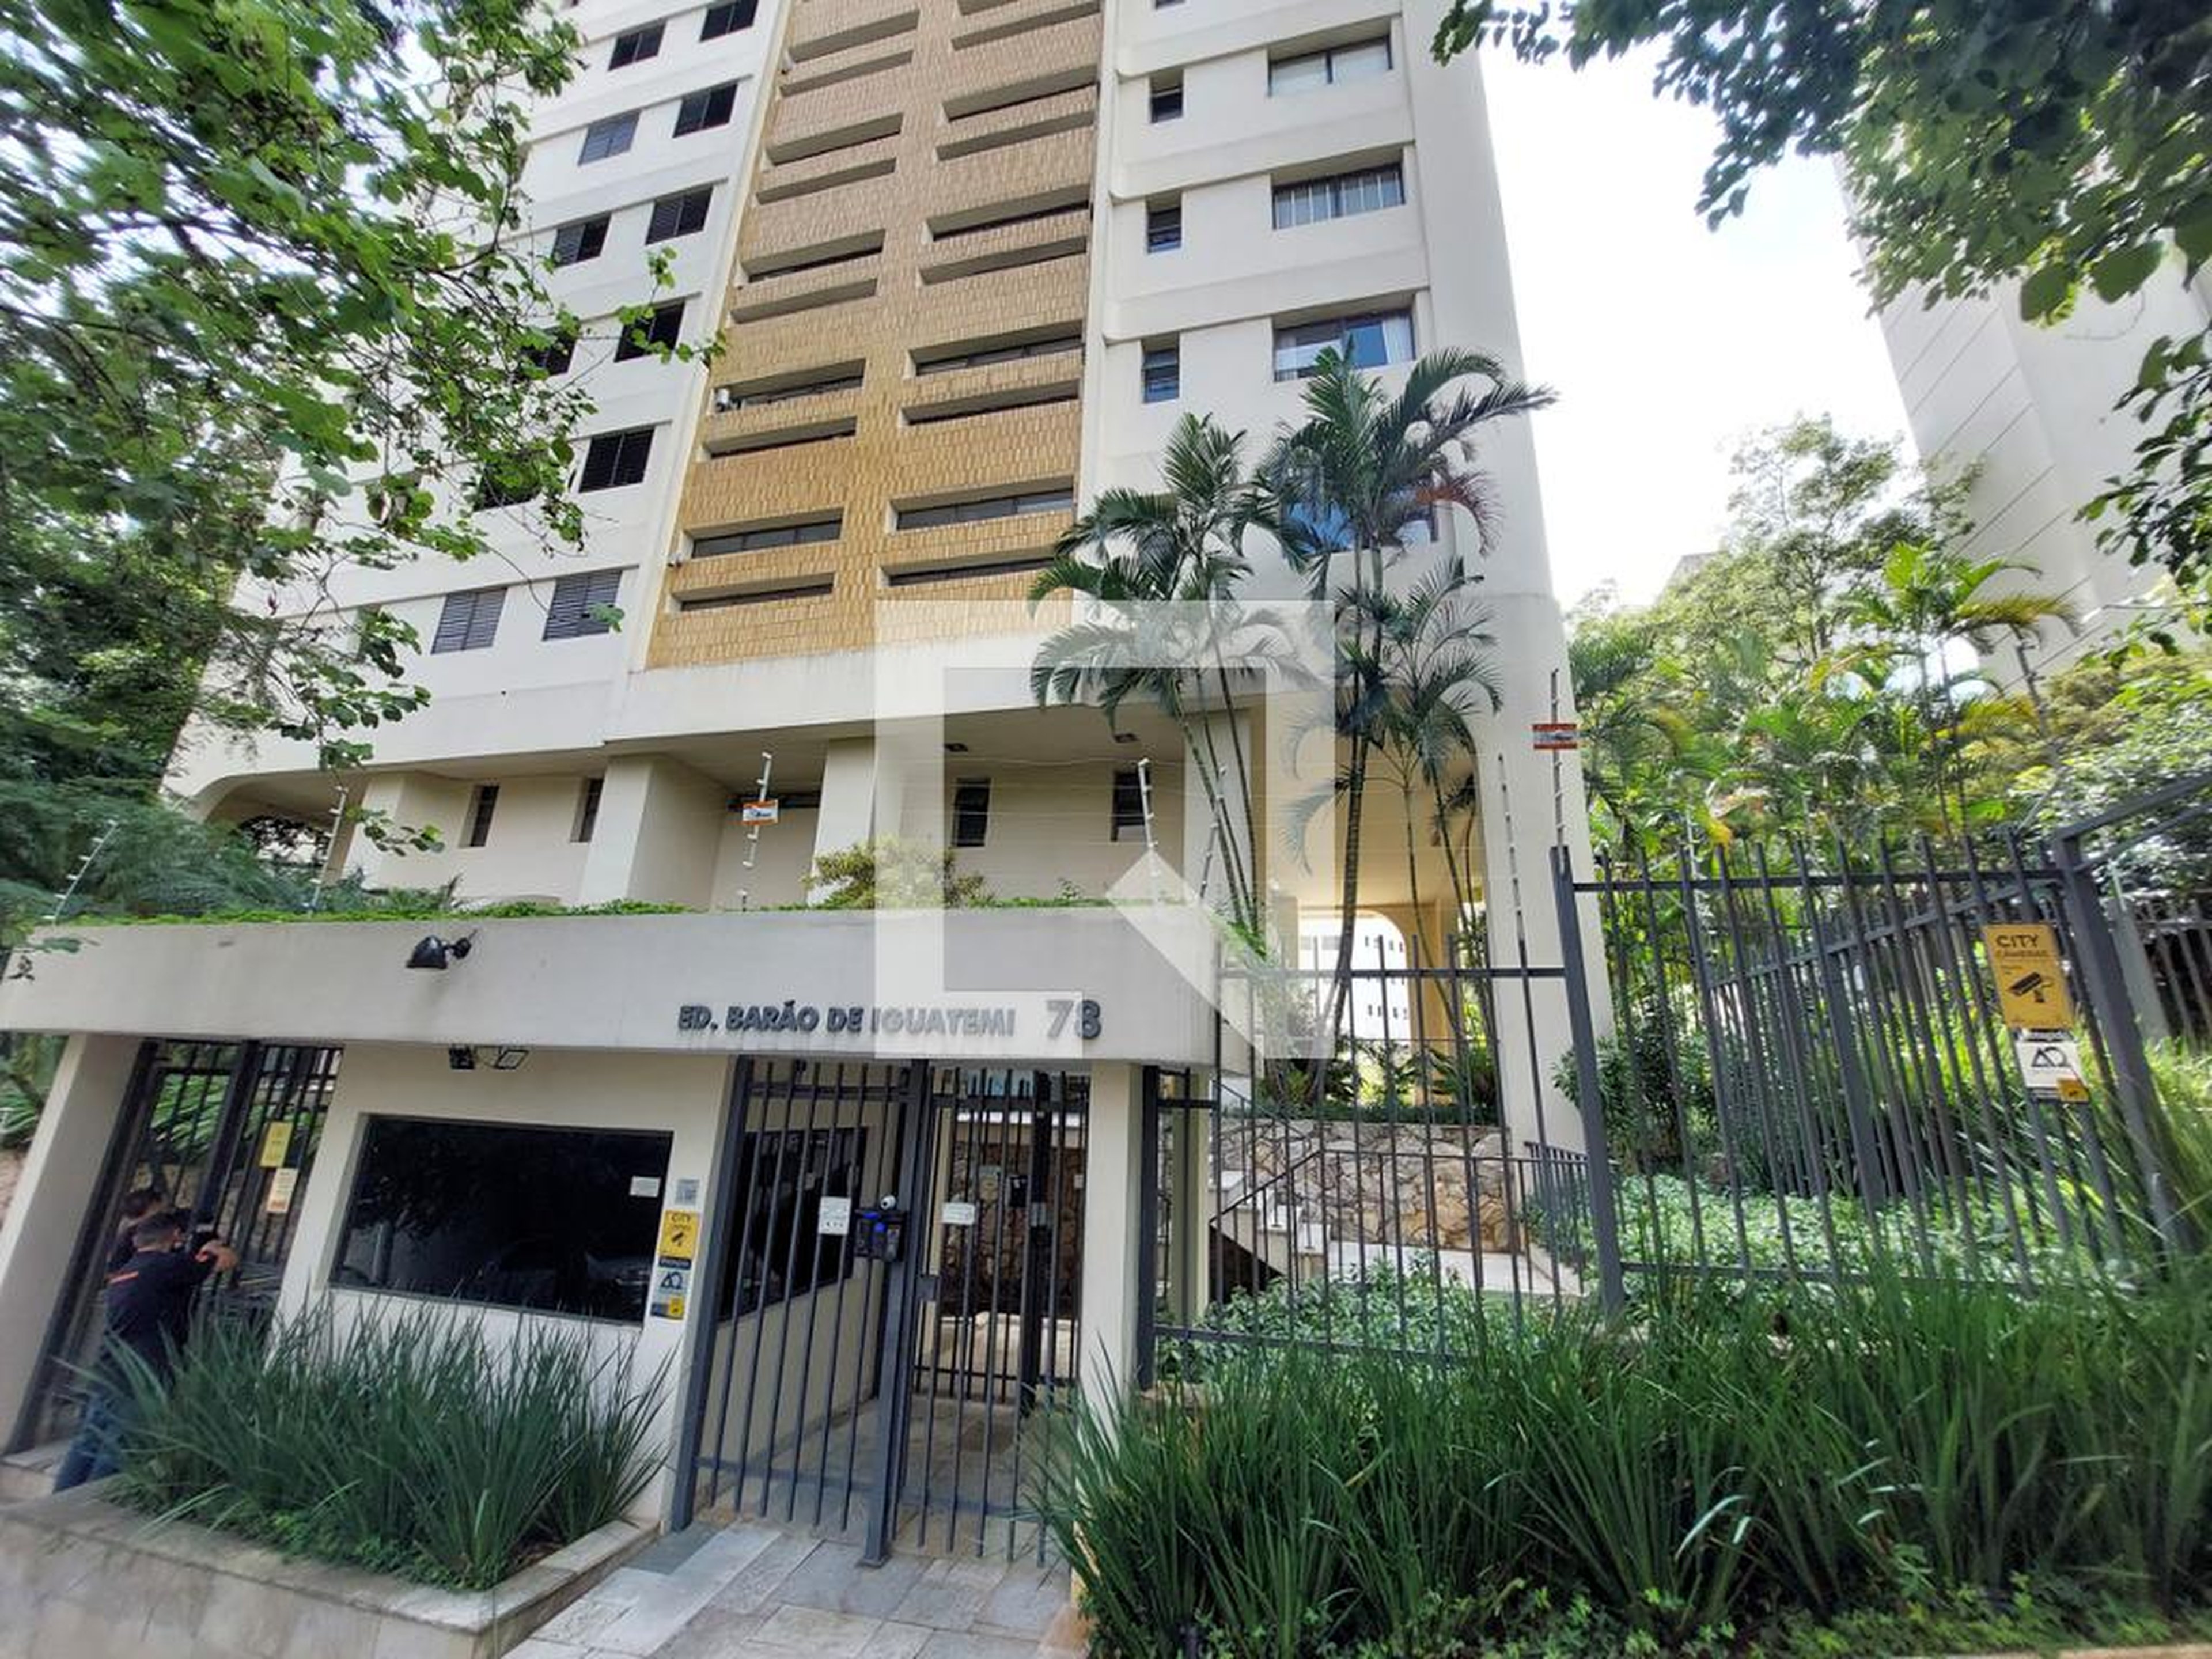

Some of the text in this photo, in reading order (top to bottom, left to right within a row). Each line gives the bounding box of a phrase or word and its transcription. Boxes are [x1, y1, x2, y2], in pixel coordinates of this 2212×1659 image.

[1996, 934, 2039, 948] CITY
[678, 1000, 1016, 1036] ED. BARÃO DE IGUATEMI
[1045, 999, 1101, 1039] 78
